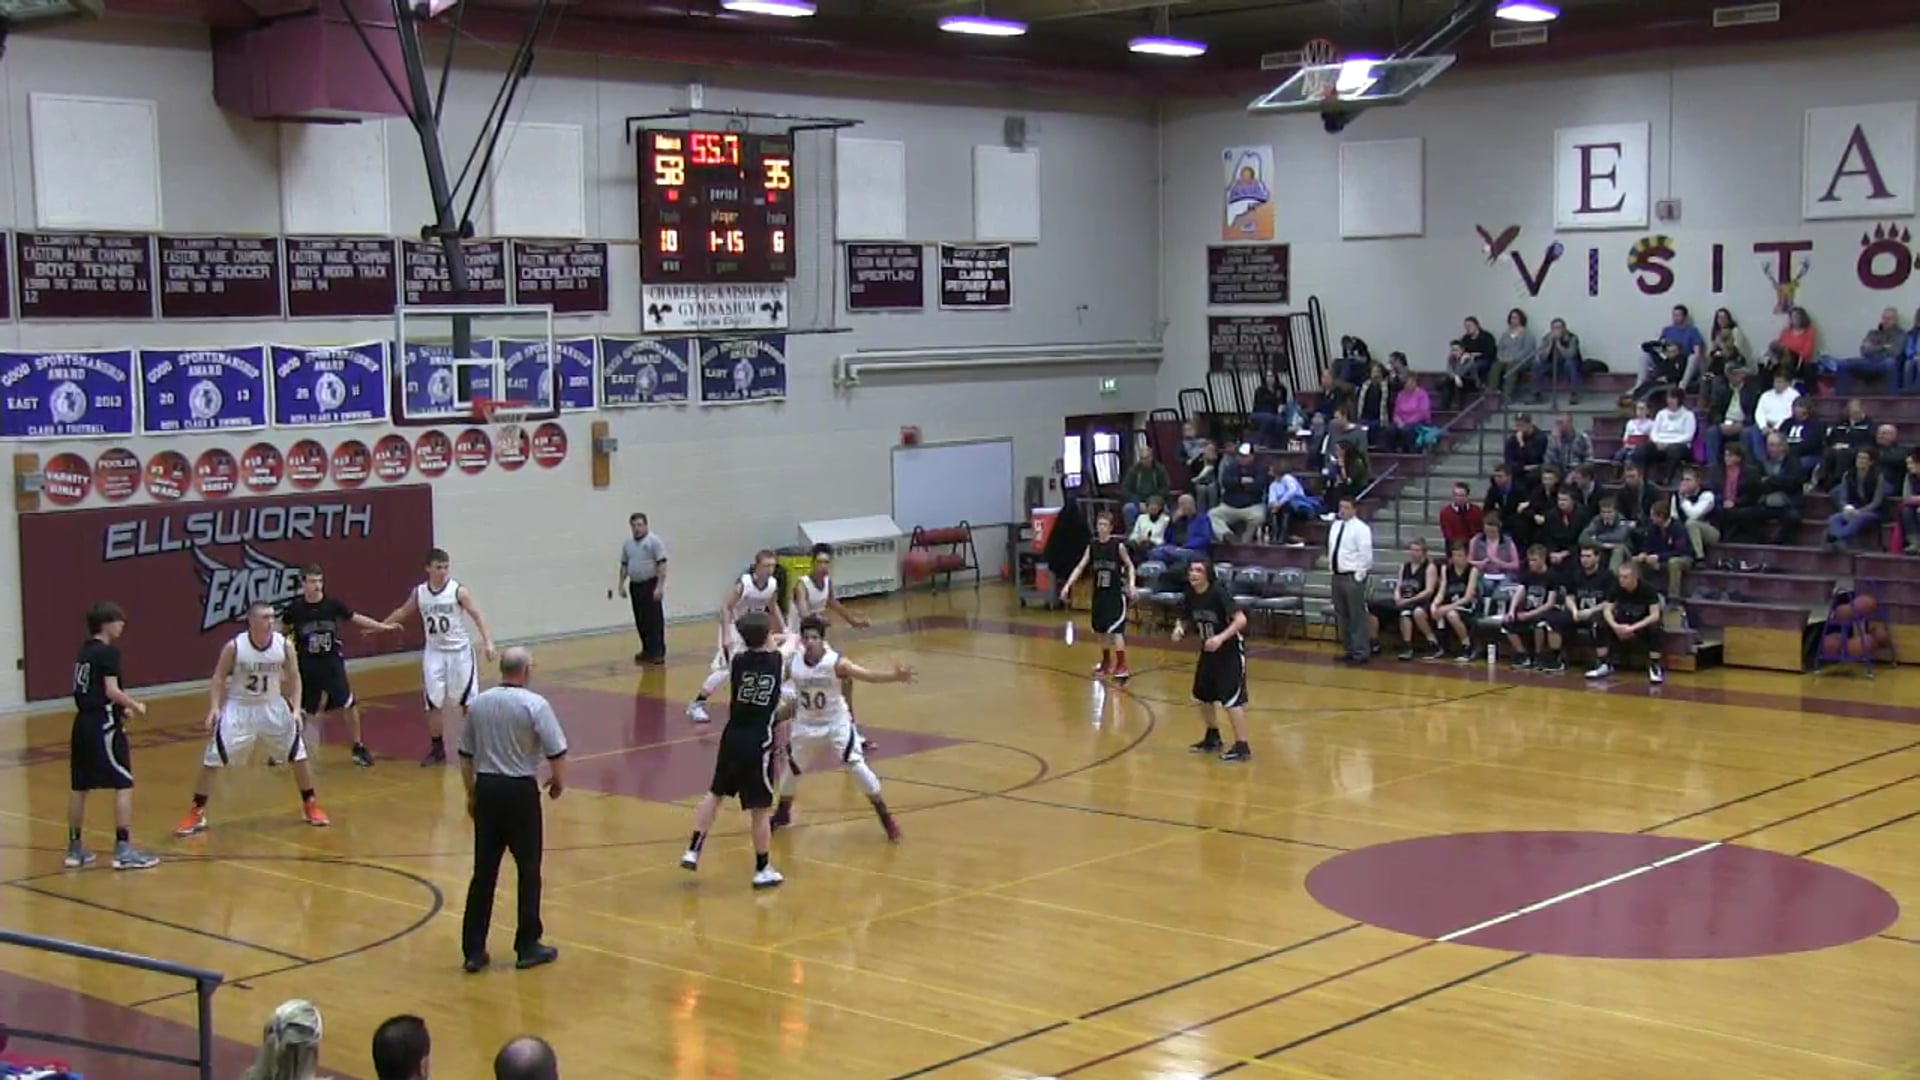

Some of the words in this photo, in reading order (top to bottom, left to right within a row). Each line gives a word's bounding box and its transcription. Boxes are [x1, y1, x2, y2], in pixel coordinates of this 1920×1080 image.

[1818, 123, 1896, 201] A
[763, 158, 790, 189] 35
[1573, 142, 1626, 214] E
[660, 230, 678, 251] 10
[773, 230, 785, 252] 6
[35, 263, 76, 276] BOYS
[82, 264, 135, 277] TENNIS
[168, 265, 211, 279] GIRLS
[215, 265, 271, 279] SOCCER
[358, 266, 387, 278] TRACK
[857, 269, 915, 281] WRESTLING
[24, 291, 39, 303] 12
[678, 301, 756, 315] GYMNASIUM
[48, 368, 86, 381] AWARD
[187, 364, 223, 377] AWARD
[611, 374, 635, 384] EAST
[7, 397, 39, 410] EAST
[98, 458, 138, 468] POOLER
[46, 471, 90, 484] VARSITY
[50, 485, 82, 496] GIRLS
[103, 504, 372, 560] ELLSWORTH
[203, 567, 304, 630] EAGLE
[426, 616, 450, 634] 20
[246, 675, 270, 691] 21
[738, 671, 776, 706] 22
